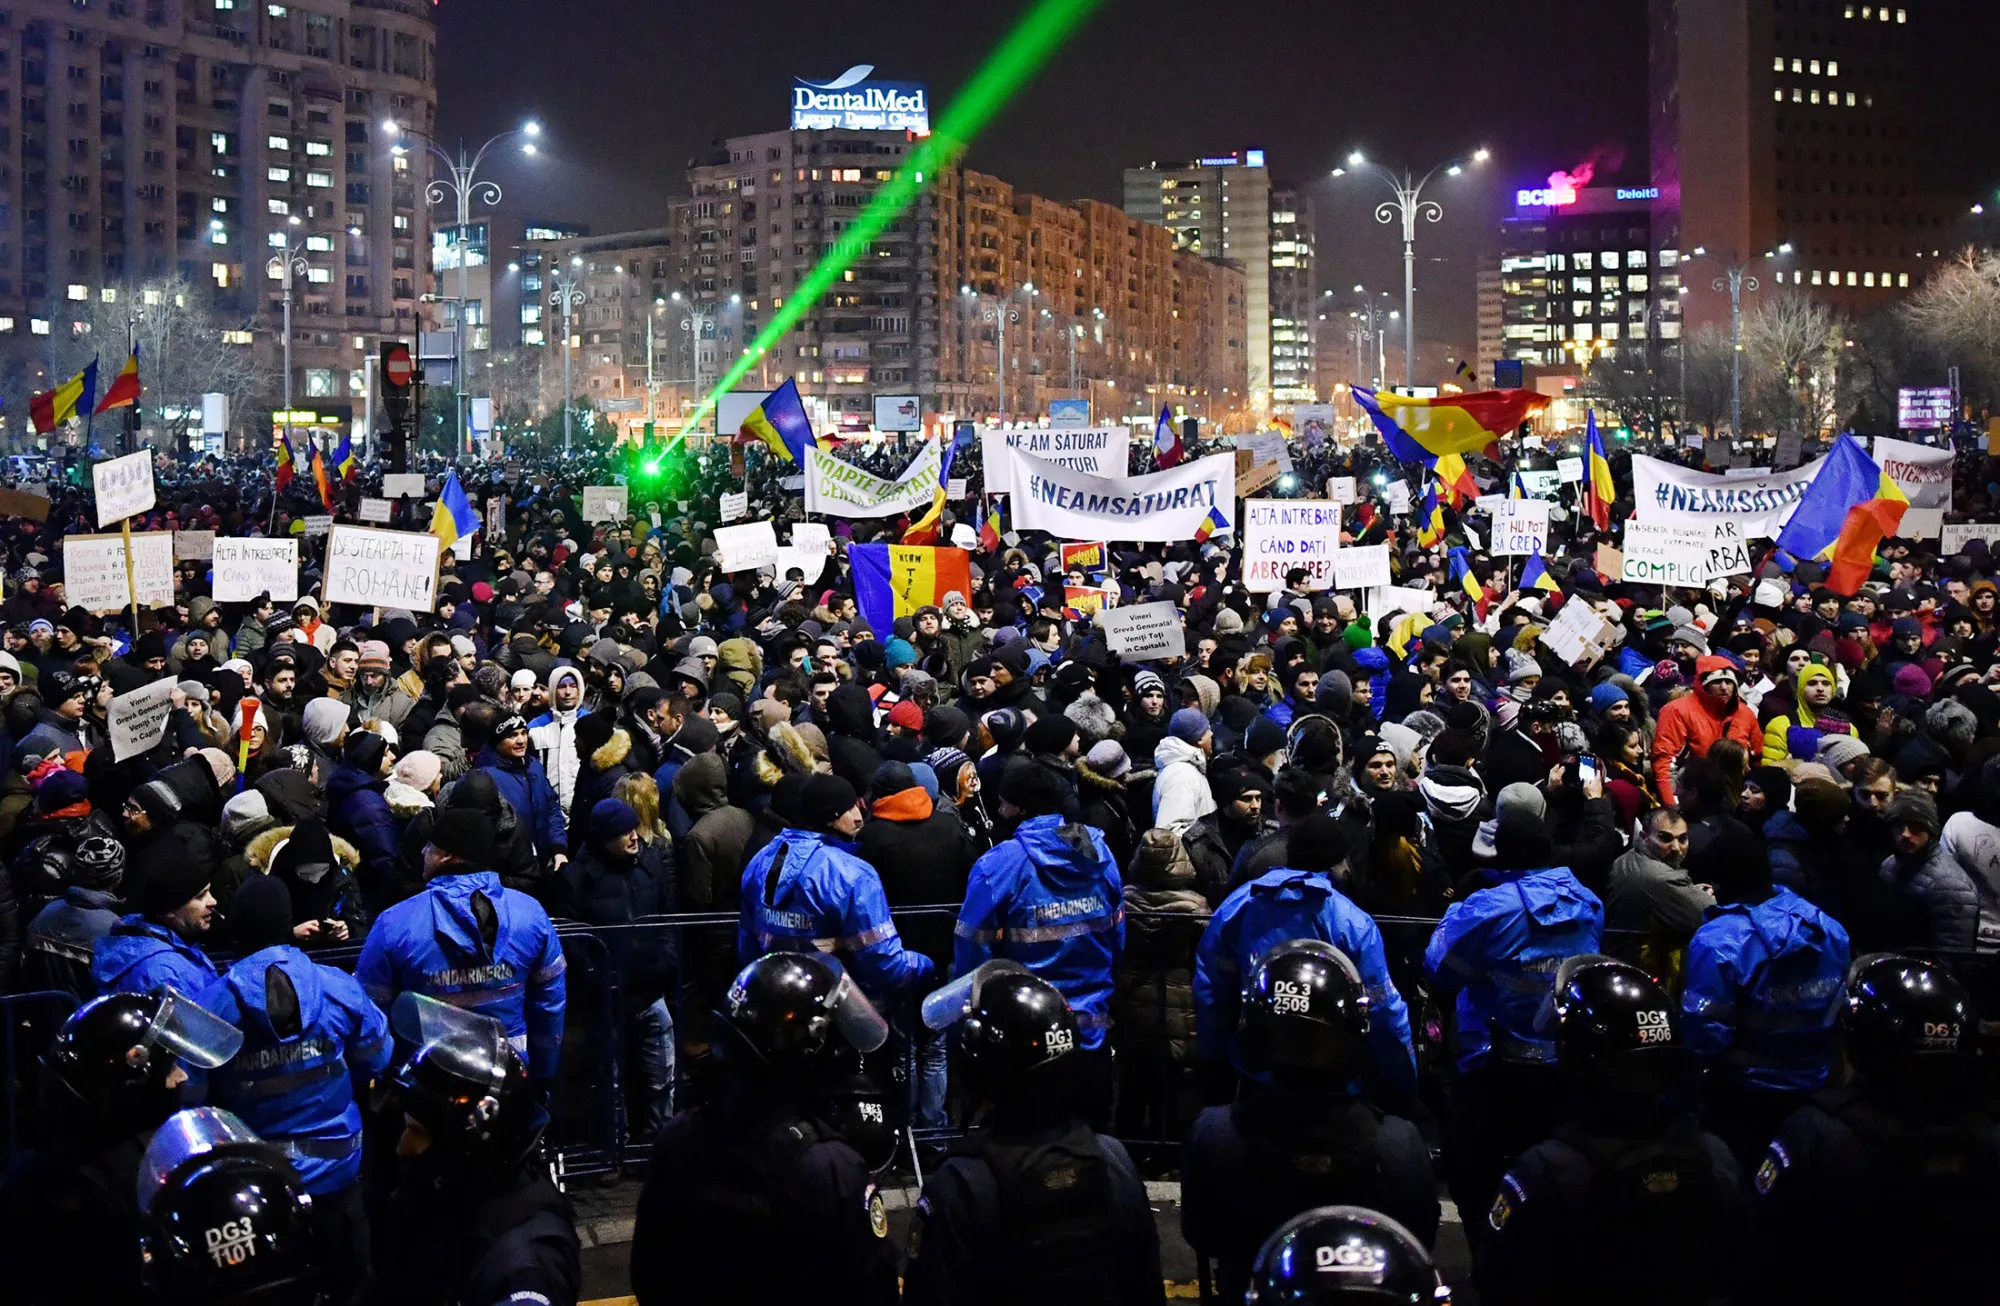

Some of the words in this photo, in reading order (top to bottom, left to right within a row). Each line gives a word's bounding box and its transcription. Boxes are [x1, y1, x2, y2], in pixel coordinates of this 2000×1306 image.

[794, 88, 925, 112] DentalMed
[1006, 434, 1050, 451] NE-AM
[1055, 429, 1108, 450] SĂTURAT
[1030, 475, 1218, 516] #NEAMSĂTURAT
[1655, 480, 1811, 513] #NEAMSĂTUR
[1250, 504, 1277, 525] ALTĂ
[1501, 501, 1515, 516] EU
[1510, 521, 1524, 533] NU
[1528, 521, 1545, 533] POT
[107, 548, 112, 556] A
[138, 541, 168, 555] LEGAL
[1260, 536, 1295, 554] CÂND
[1509, 535, 1541, 551] CRED
[140, 556, 168, 568] LEGAL
[1624, 559, 1703, 583] COMPLICI
[343, 566, 430, 602] ROMÂNE!
[1129, 612, 1152, 621] Vineri
[130, 693, 151, 707] Vineri
[1274, 996, 1310, 1013] 2509
[1635, 1010, 1668, 1026] DG3
[1045, 1028, 1073, 1046] DG3
[1640, 1028, 1672, 1043] 2506
[205, 1216, 253, 1249] DG3
[212, 1239, 256, 1269] 1101
[1316, 1244, 1374, 1266] DG3
